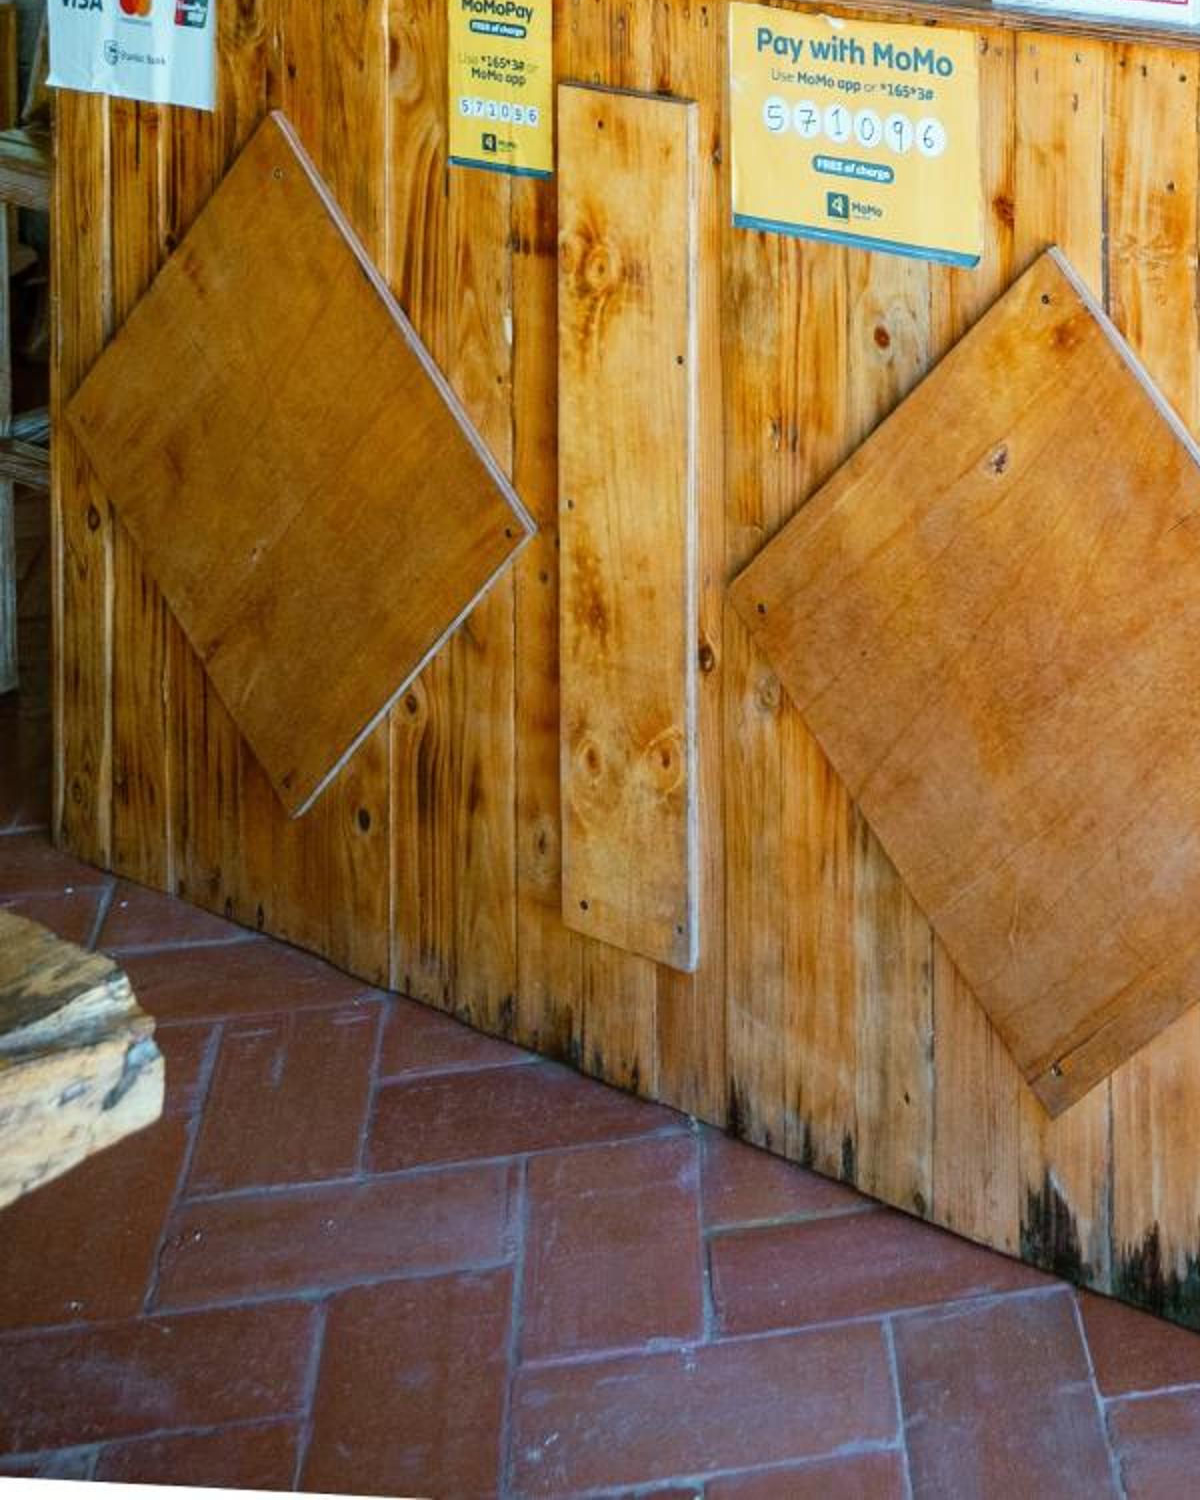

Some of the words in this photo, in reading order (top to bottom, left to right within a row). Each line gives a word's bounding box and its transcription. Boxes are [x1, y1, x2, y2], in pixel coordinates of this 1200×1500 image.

[756, 27, 803, 63] Pay
[809, 35, 865, 66] with
[872, 41, 954, 78] MoMo
[471, 67, 504, 83] MoMo
[505, 72, 526, 87] app
[771, 67, 795, 82] Use
[797, 70, 835, 88] MoMo
[837, 77, 861, 93] app
[863, 83, 876, 93] or
[766, 104, 936, 151] 571096
[851, 201, 884, 218] MoMo
